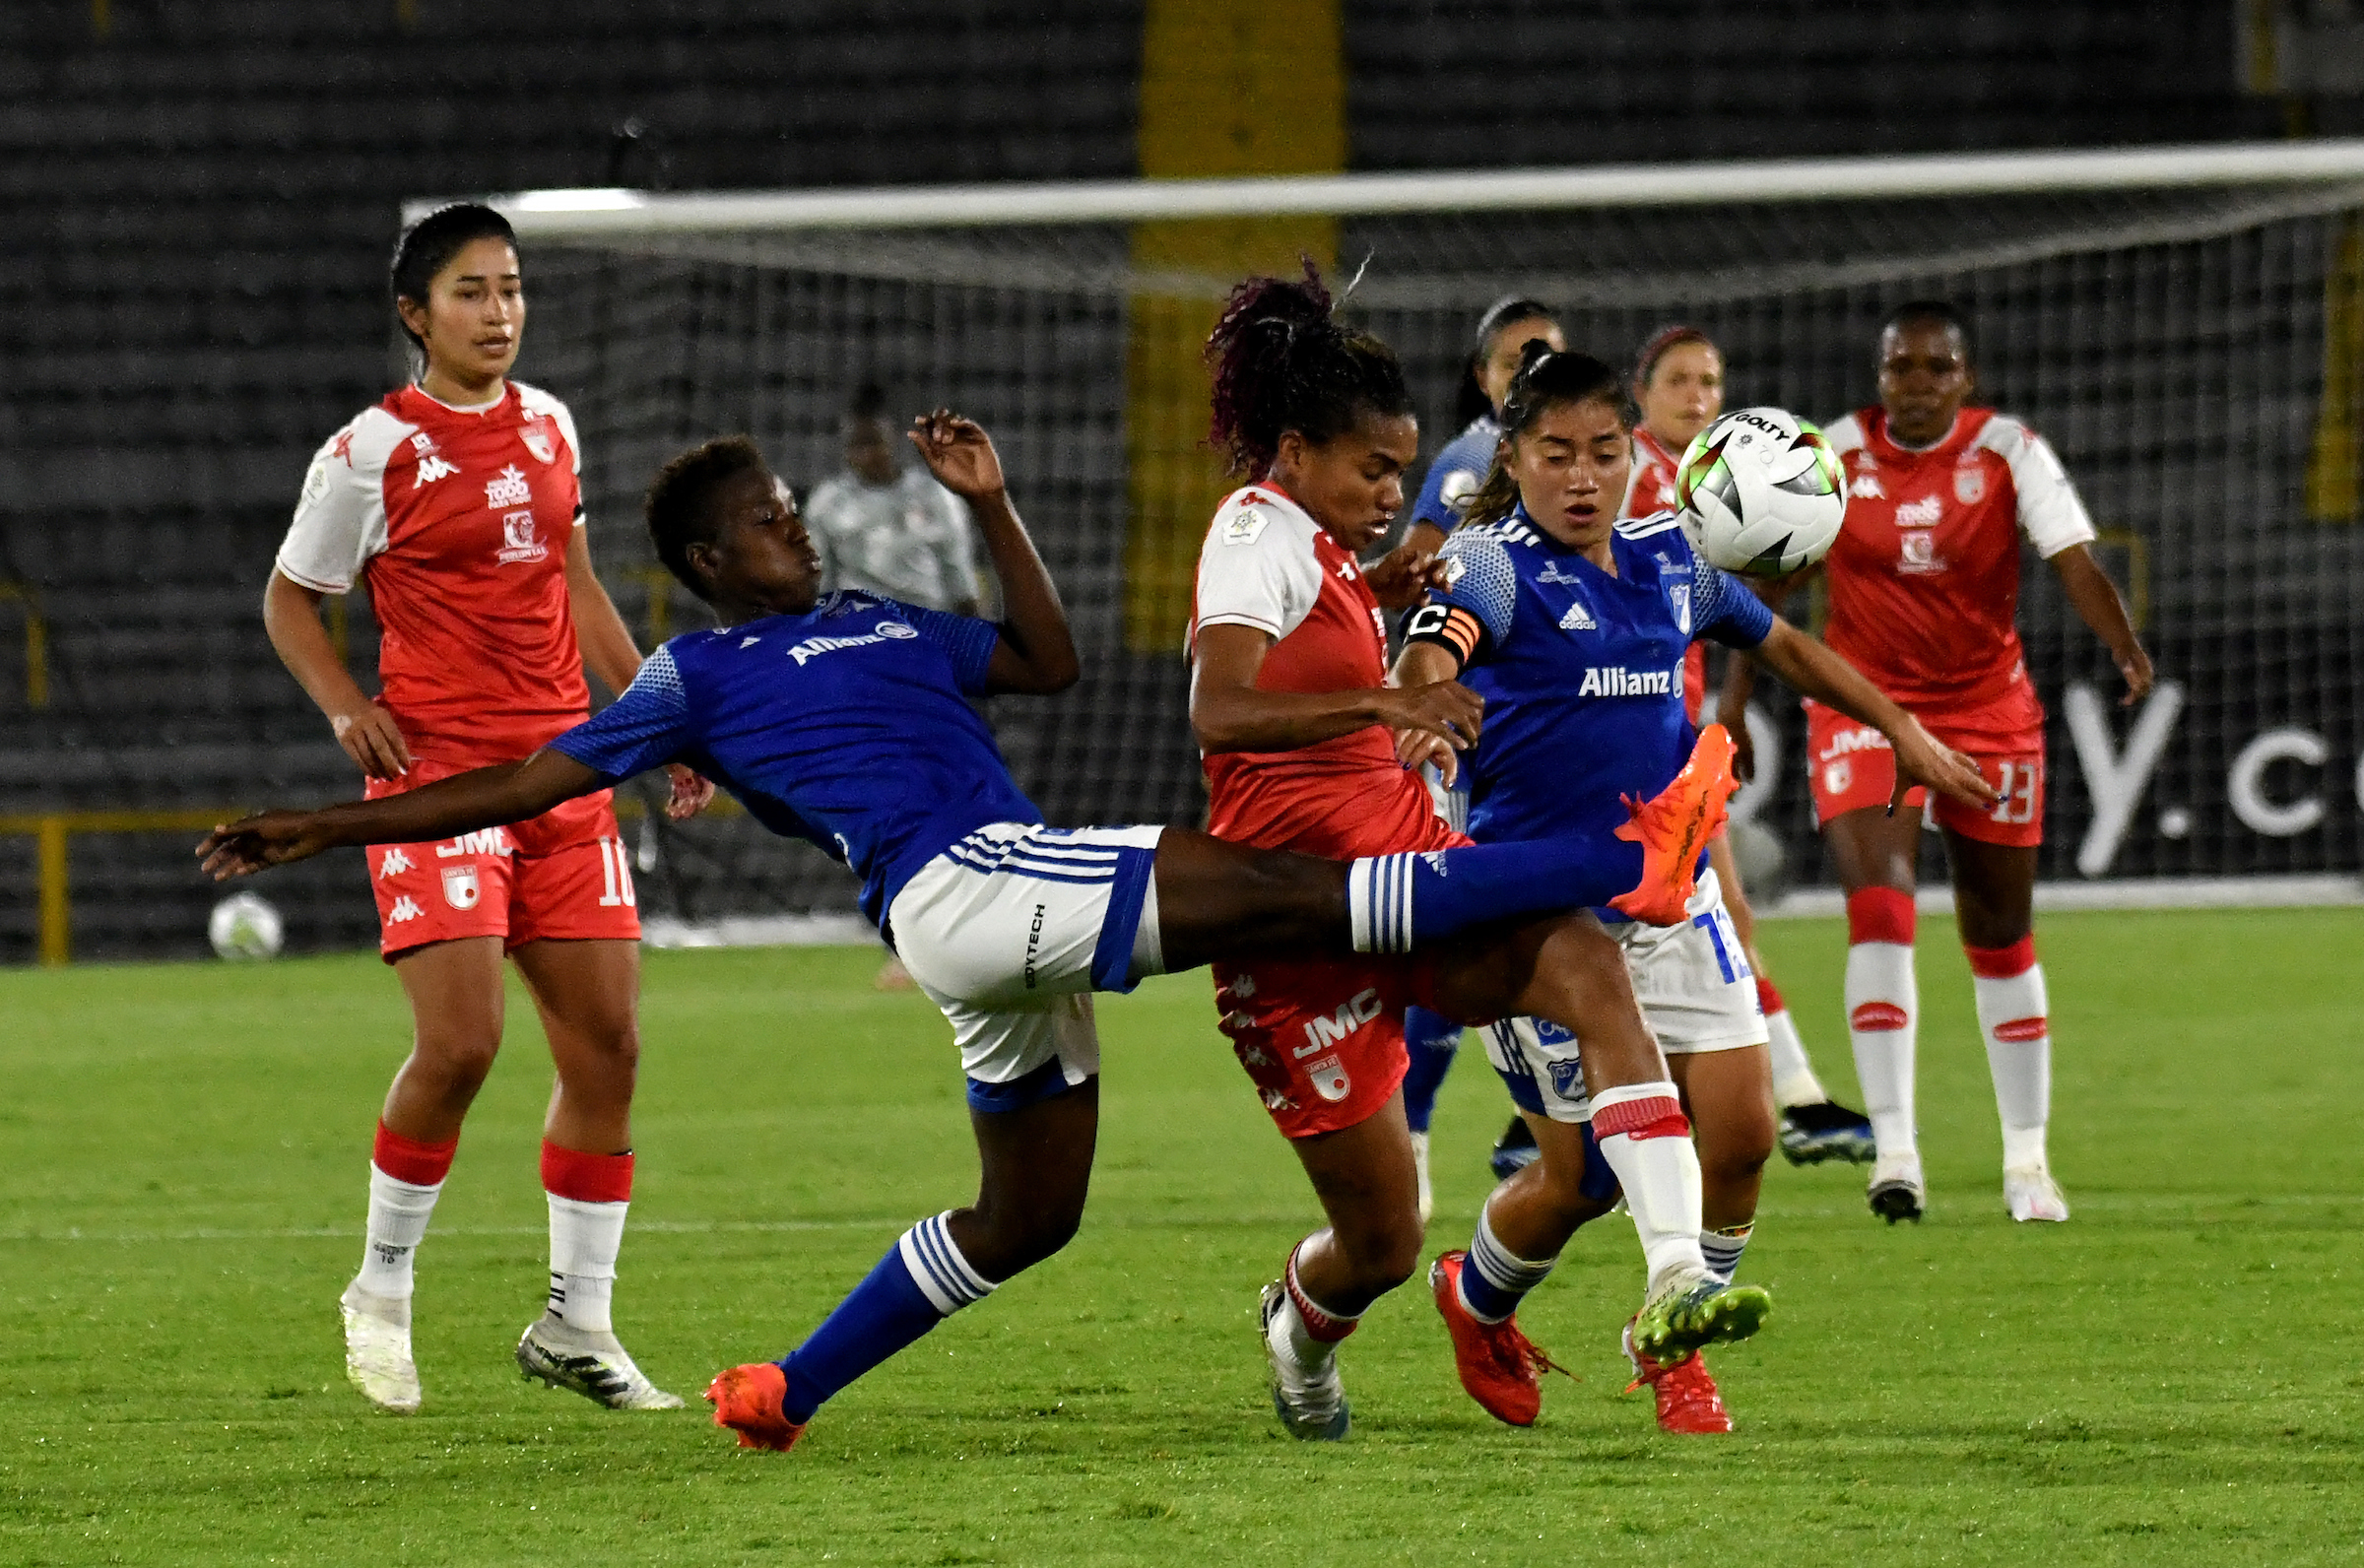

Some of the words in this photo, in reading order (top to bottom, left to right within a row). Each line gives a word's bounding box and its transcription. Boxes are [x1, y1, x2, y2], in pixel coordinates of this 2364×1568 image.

[1735, 414, 1790, 441] GOLTY
[1409, 605, 1447, 634] C
[1559, 620, 1597, 630] adidas
[787, 634, 886, 667] Allianz
[1578, 667, 1670, 697] Allianz
[1991, 762, 2034, 823] 13
[1025, 904, 1046, 989] BODYTECH
[1293, 988, 1382, 1059] JMC
